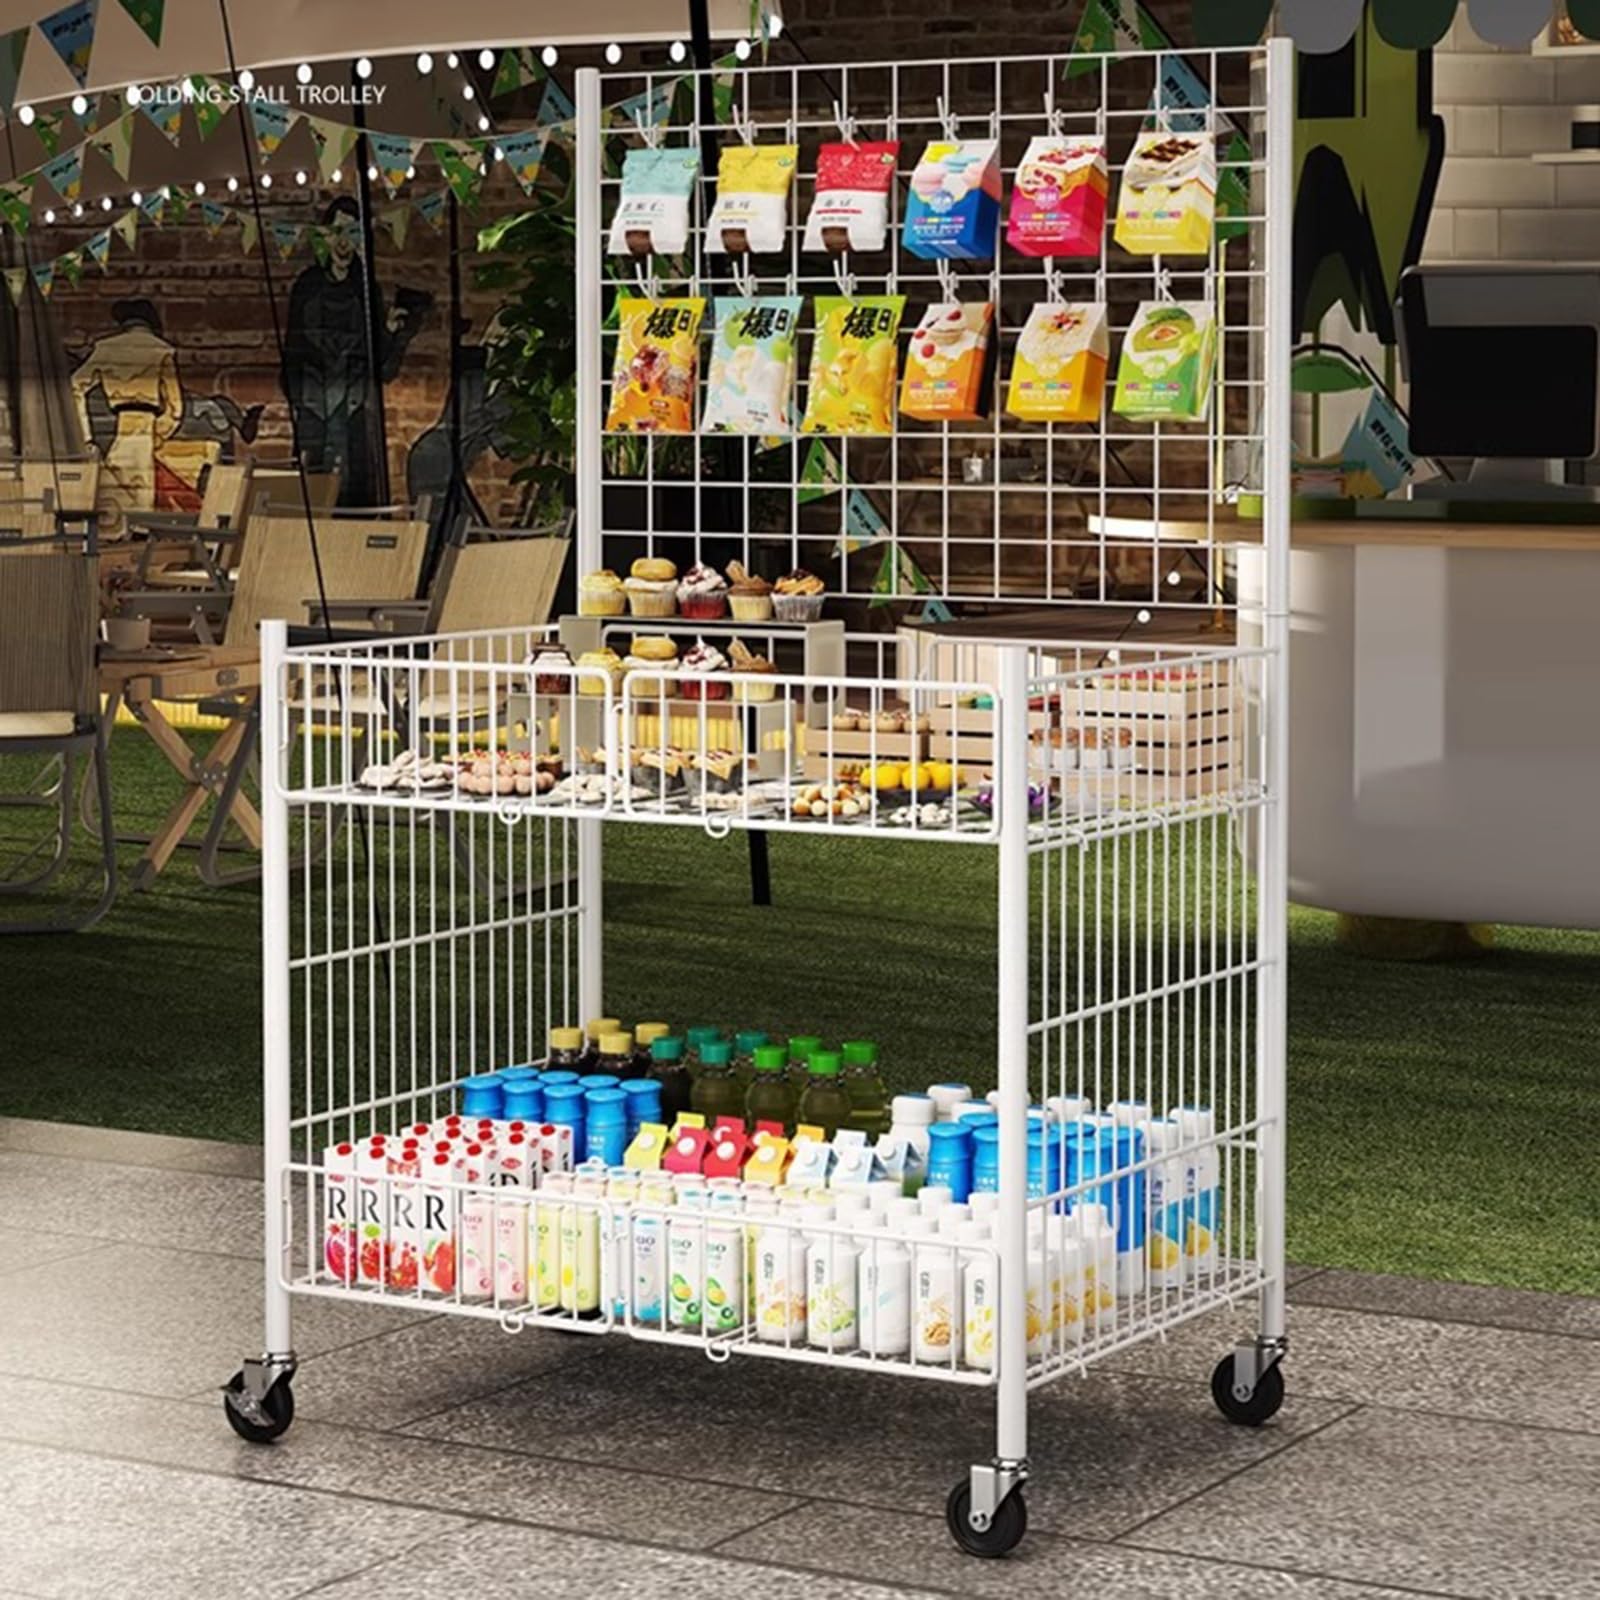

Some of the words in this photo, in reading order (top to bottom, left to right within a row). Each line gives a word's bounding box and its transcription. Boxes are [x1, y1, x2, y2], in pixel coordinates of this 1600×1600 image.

[328, 1186, 346, 1219] R
[361, 1189, 380, 1223] R
[394, 1194, 415, 1228] R
[425, 1194, 447, 1231] R
